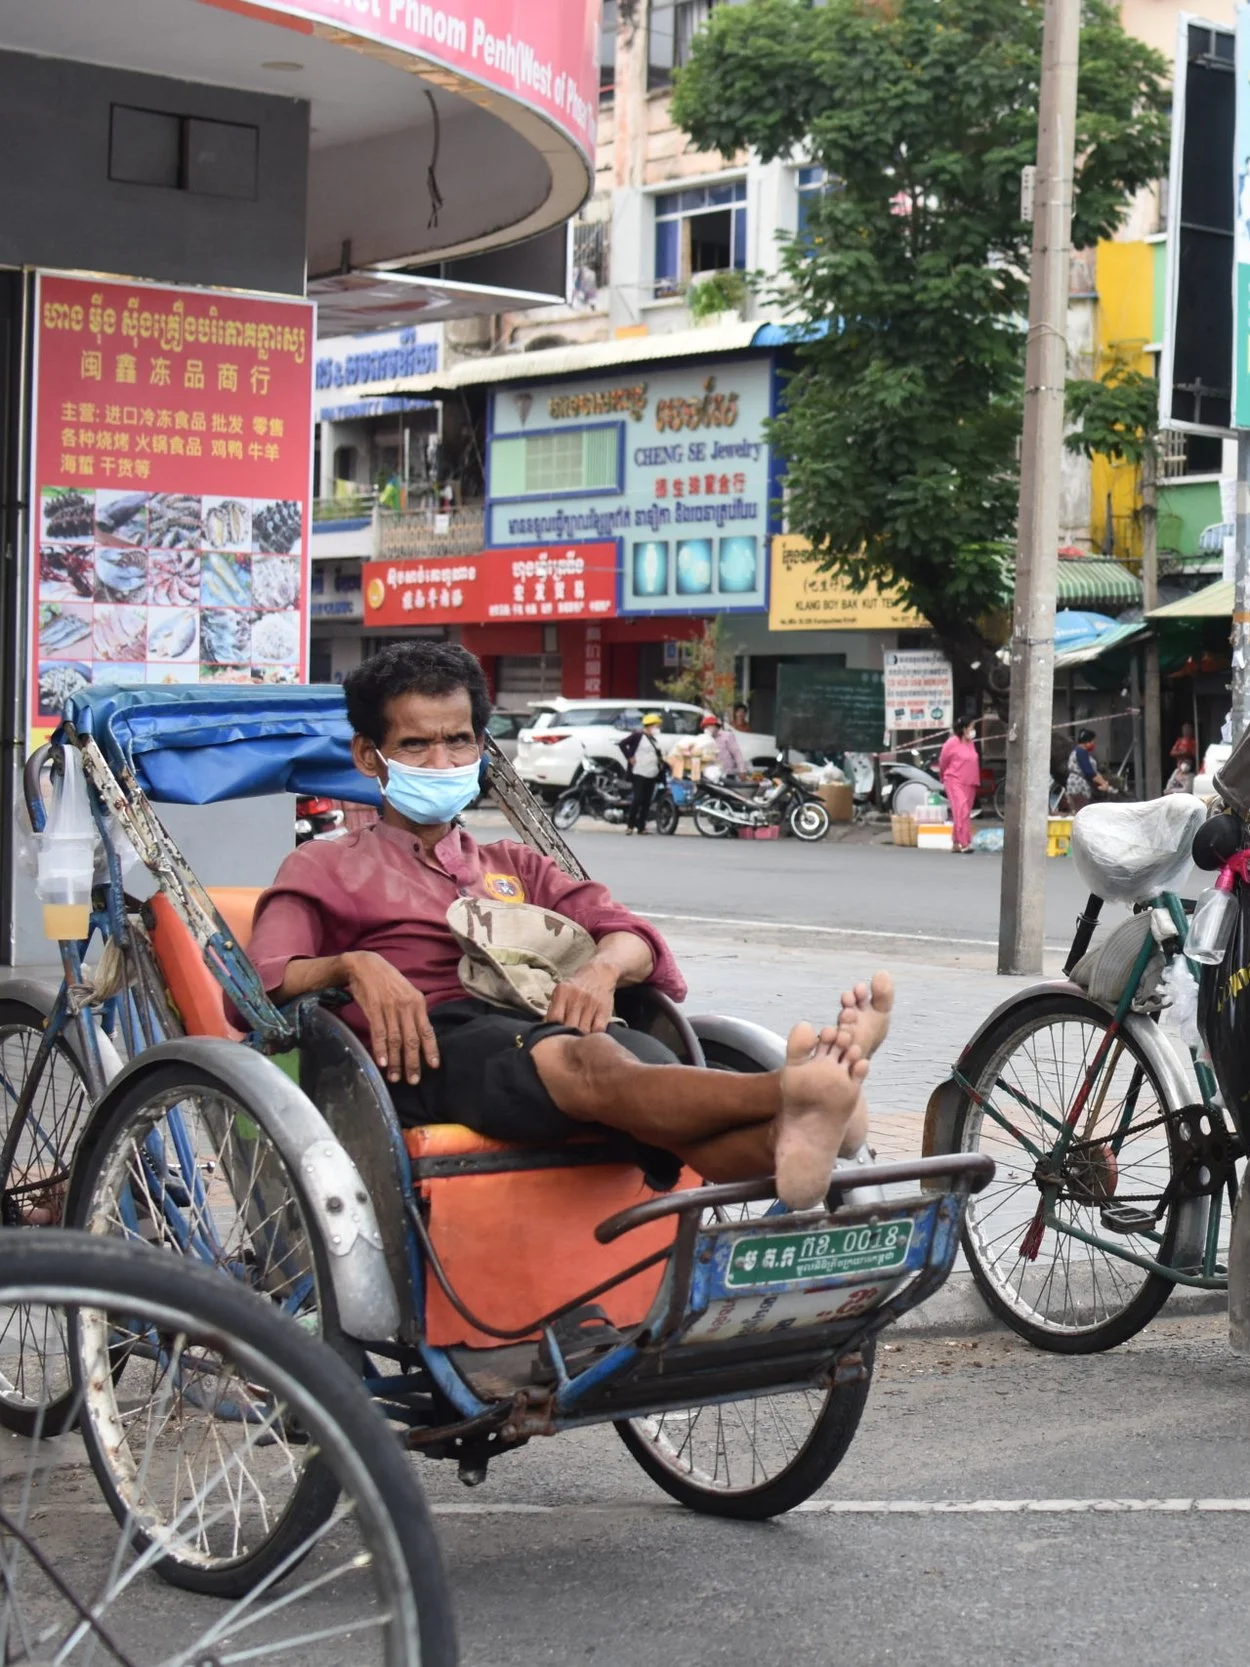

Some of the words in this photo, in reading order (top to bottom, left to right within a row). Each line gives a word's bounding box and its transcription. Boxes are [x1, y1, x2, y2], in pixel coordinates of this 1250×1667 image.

[389, 0, 467, 54] Phnom
[211, 412, 244, 435] 批发
[247, 441, 280, 462] 牛羊
[634, 444, 683, 467] CHENG
[687, 441, 707, 462] SE
[710, 438, 762, 463] Jewelry
[795, 600, 821, 611] KLANG
[862, 599, 878, 609] KUT
[843, 1226, 899, 1251] 0018
